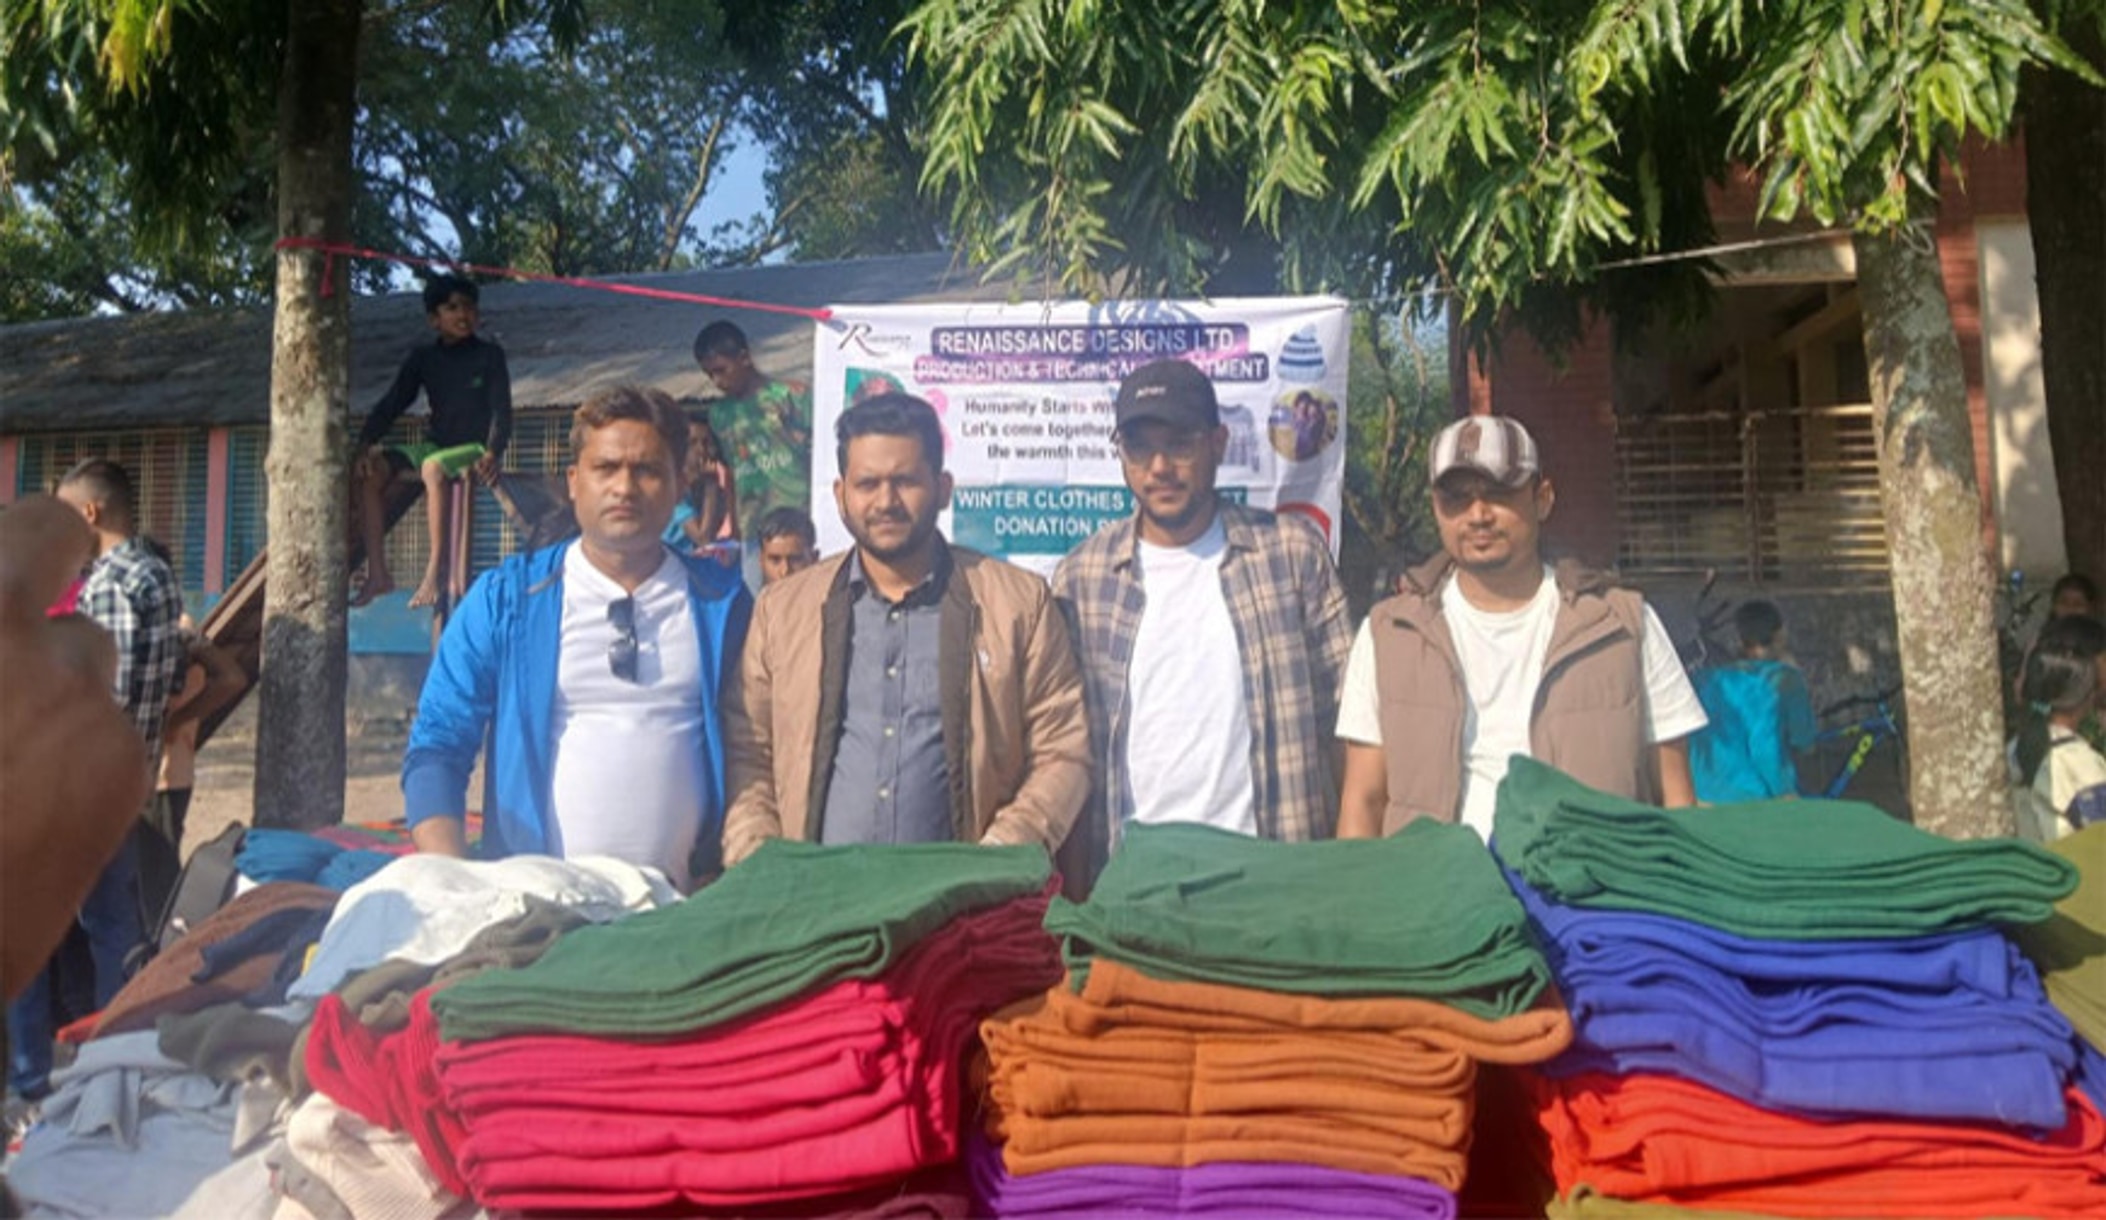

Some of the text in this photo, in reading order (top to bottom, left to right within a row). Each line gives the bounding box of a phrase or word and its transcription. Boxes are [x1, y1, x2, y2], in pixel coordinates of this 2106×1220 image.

[938, 329, 1085, 353] RENAISSANCE
[1091, 327, 1187, 352] DESIGNS
[916, 360, 1023, 380] PRODUCTION
[1027, 361, 1040, 380] &
[965, 400, 1037, 416] Humanity
[1040, 398, 1088, 415] Starts
[961, 421, 998, 437] Let's
[1002, 424, 1044, 437] come
[987, 445, 1011, 459] the
[1015, 445, 1073, 459] warmth
[1077, 445, 1106, 459] this
[956, 489, 1030, 509] WINTER
[1034, 489, 1125, 511] CLOTHES
[994, 516, 1092, 537] DONATION
